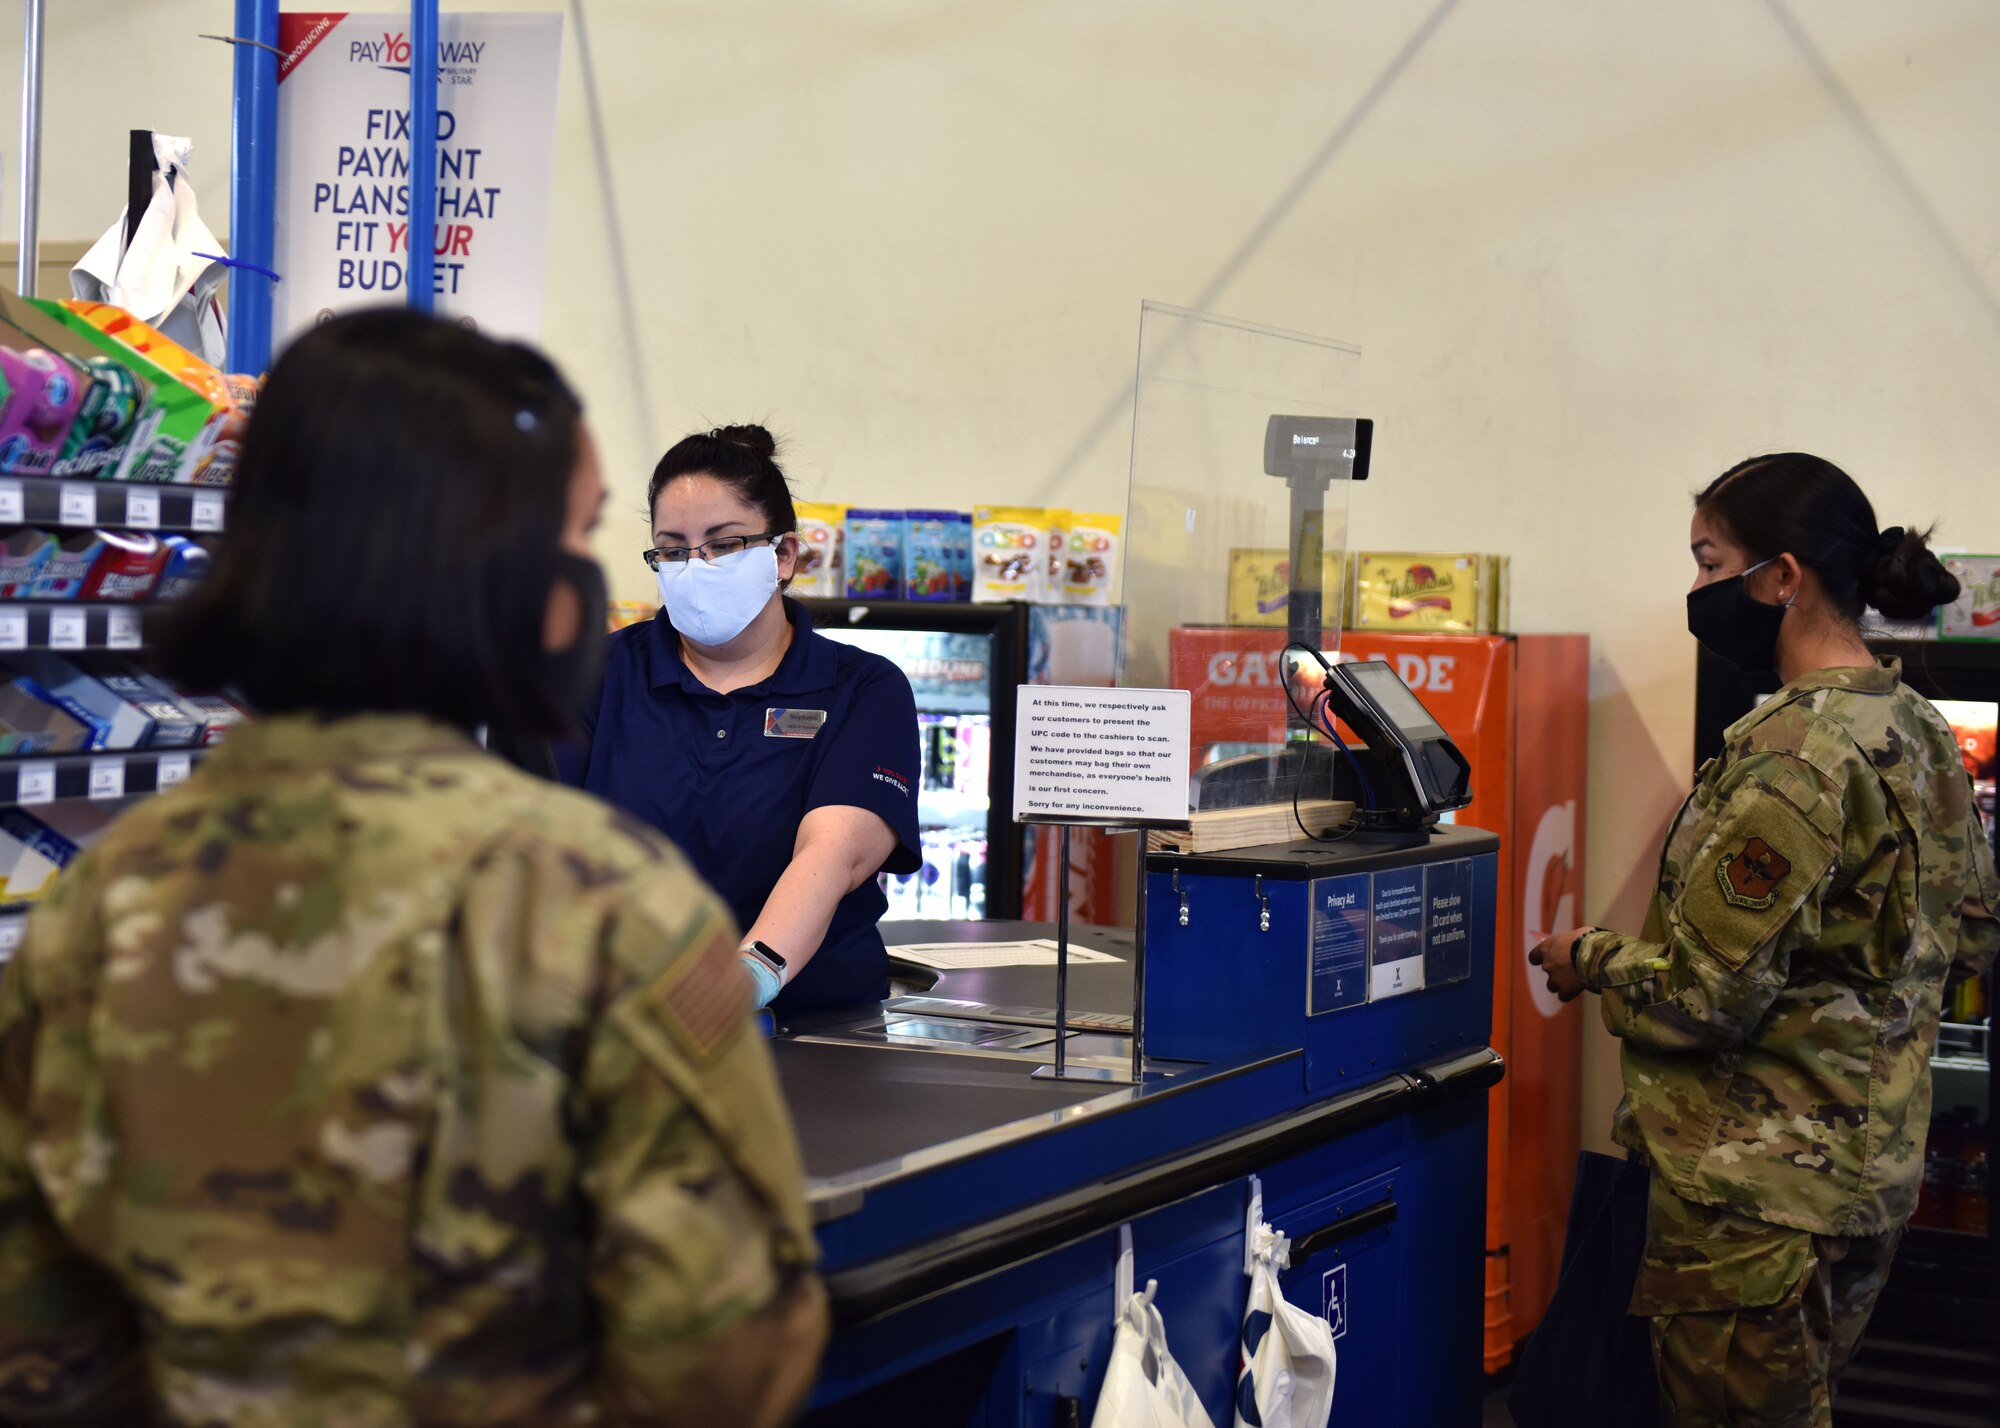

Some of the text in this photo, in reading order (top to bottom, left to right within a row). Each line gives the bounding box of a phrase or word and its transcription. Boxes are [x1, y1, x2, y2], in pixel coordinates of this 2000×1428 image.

[280, 16, 329, 71] INRODUCING
[349, 41, 386, 63] PAY
[438, 41, 485, 63] WAY
[367, 109, 456, 141] FIXD
[338, 146, 482, 180] PAYMNT
[314, 183, 501, 219] PLANS HAT
[336, 221, 473, 256] FIT YUR
[338, 258, 464, 294] BUDET
[1061, 700, 1082, 708] time,
[1099, 702, 1150, 712] respectively
[1103, 718, 1134, 727] present
[1066, 747, 1102, 756] provided
[1104, 749, 1124, 757] bags
[1094, 761, 1110, 769] bag
[873, 773, 884, 781] WE
[884, 776, 898, 787] GIVE
[1029, 770, 1084, 779] merchandise,
[1098, 773, 1143, 782] everyone's
[1028, 800, 1050, 809] Sorry
[1082, 803, 1144, 811] inconvenience.
[1327, 892, 1355, 909] Privacy Act
[1433, 892, 1461, 910] Please show
[1432, 910, 1463, 928] ID card when
[1432, 933, 1441, 946] not
